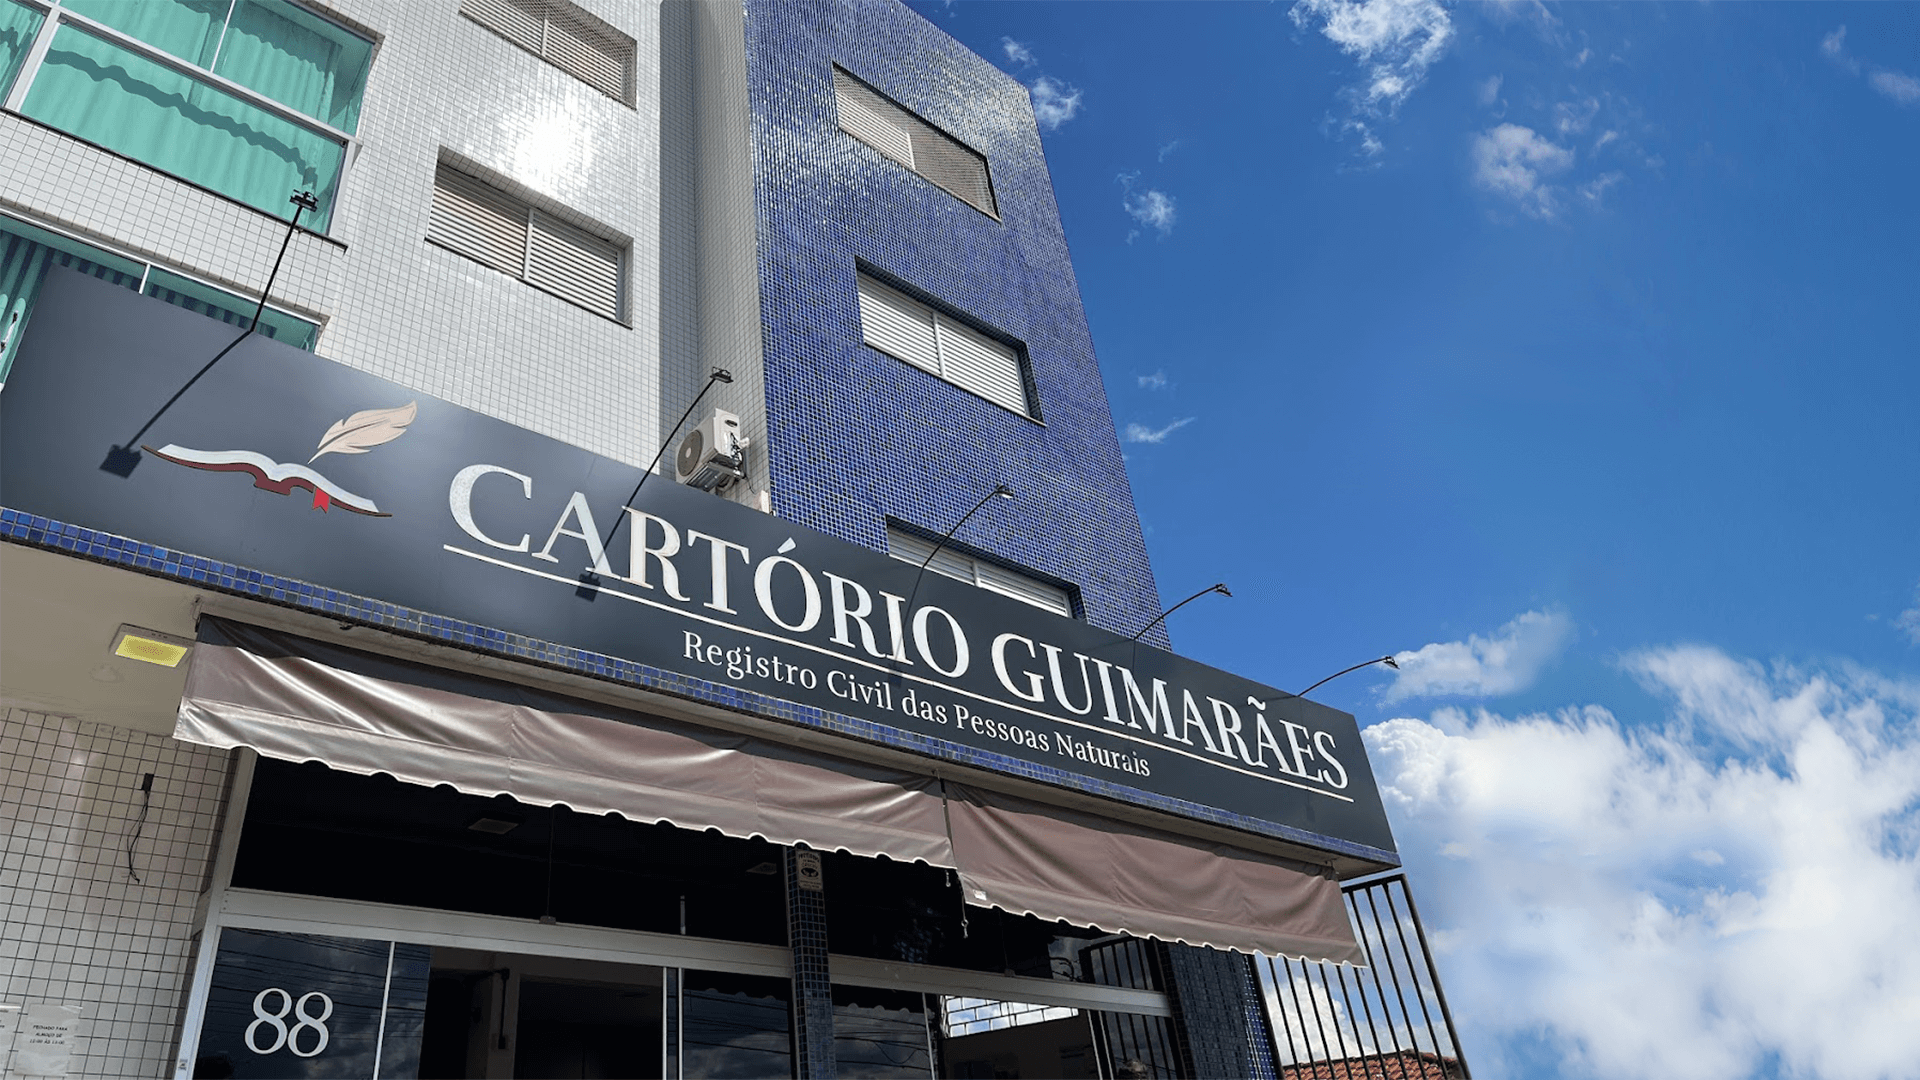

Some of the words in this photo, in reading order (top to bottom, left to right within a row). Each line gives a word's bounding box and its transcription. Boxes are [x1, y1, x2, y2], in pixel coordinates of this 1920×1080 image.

[449, 464, 970, 679] CARTÓRIO
[991, 632, 1349, 788] GUIMARÃES
[682, 630, 817, 690] Registro
[827, 670, 894, 711] Civil
[902, 689, 948, 724] das
[953, 703, 1050, 751] Pessoas
[1054, 731, 1150, 777] Naturais
[244, 987, 334, 1058] 88
